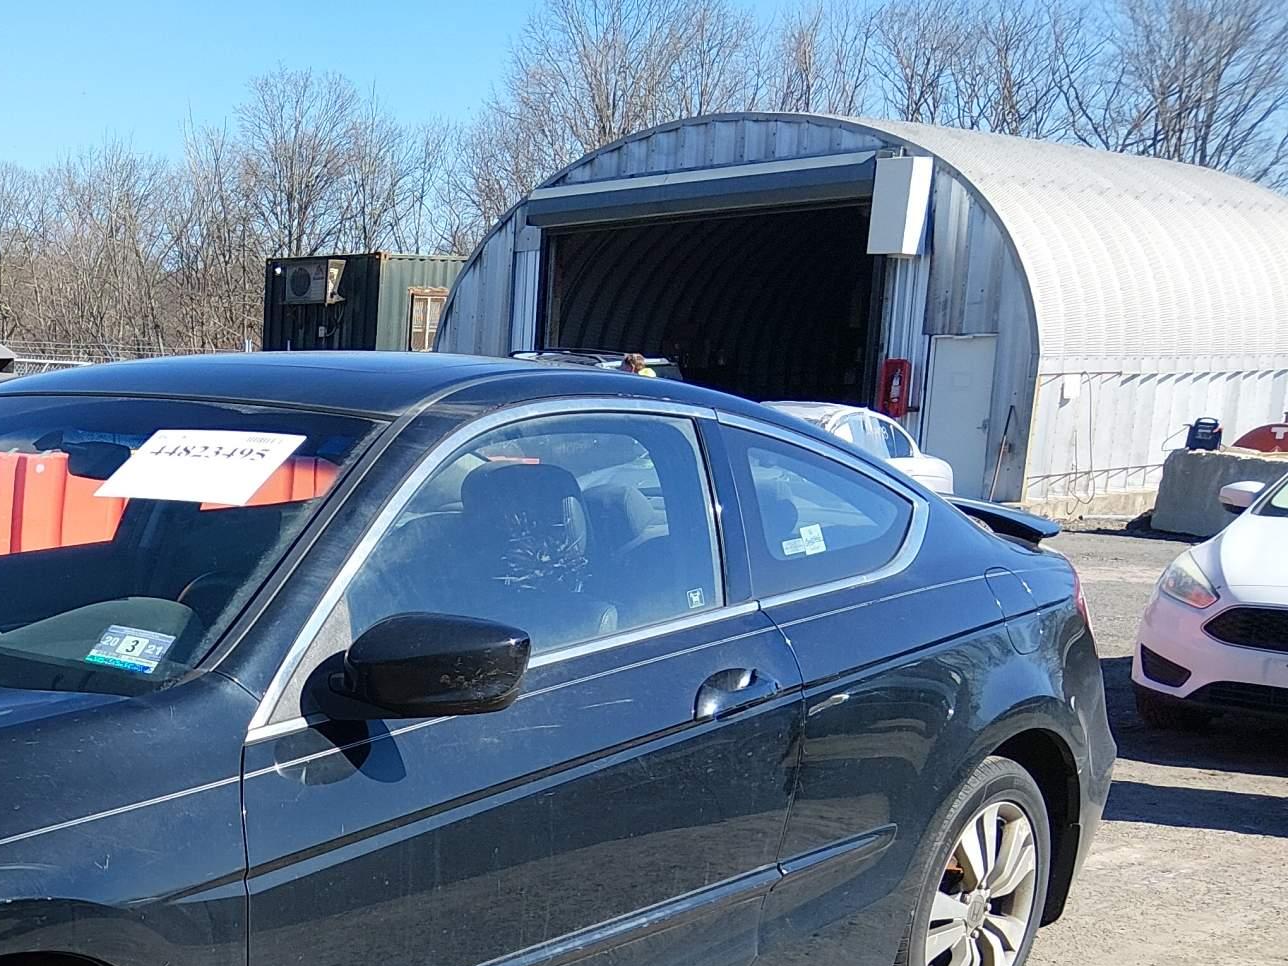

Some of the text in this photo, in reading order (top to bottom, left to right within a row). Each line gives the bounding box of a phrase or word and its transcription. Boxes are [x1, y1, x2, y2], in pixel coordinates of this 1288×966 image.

[150, 445, 270, 461] 44823495
[104, 635, 163, 655] 20 3 21
